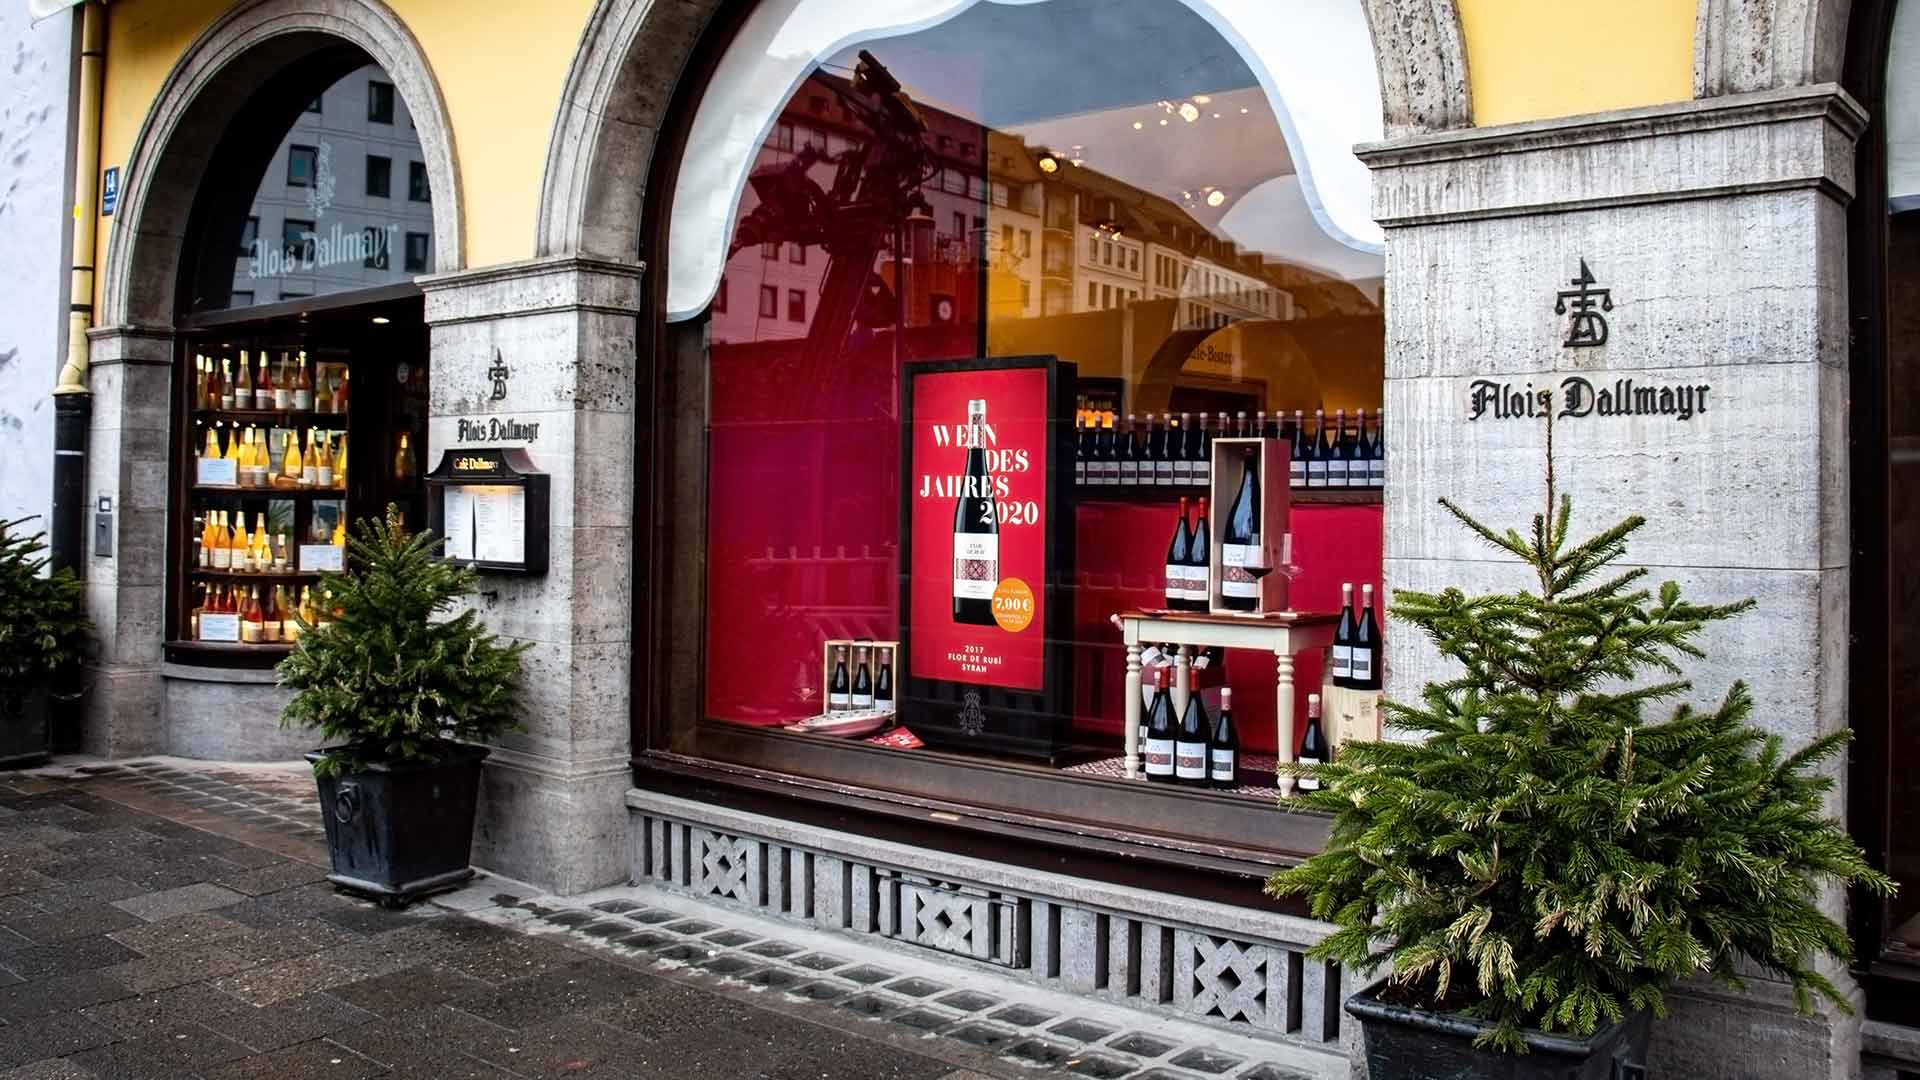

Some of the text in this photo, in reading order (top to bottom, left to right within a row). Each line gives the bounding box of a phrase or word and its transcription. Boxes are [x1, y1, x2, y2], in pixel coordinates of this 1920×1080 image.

[248, 222, 399, 279] Alois Dallmayr
[1468, 376, 1711, 421] Alois Dallmayr
[457, 417, 540, 443] Alois Dallmayr
[931, 423, 998, 448] WEIN
[985, 448, 1030, 473] DES
[919, 474, 1009, 498] JAHRES
[979, 500, 1039, 525] 2020
[948, 653, 967, 662] FLOR
[970, 655, 980, 663] DE
[964, 645, 984, 654] 2017
[961, 663, 987, 673] SYRAH
